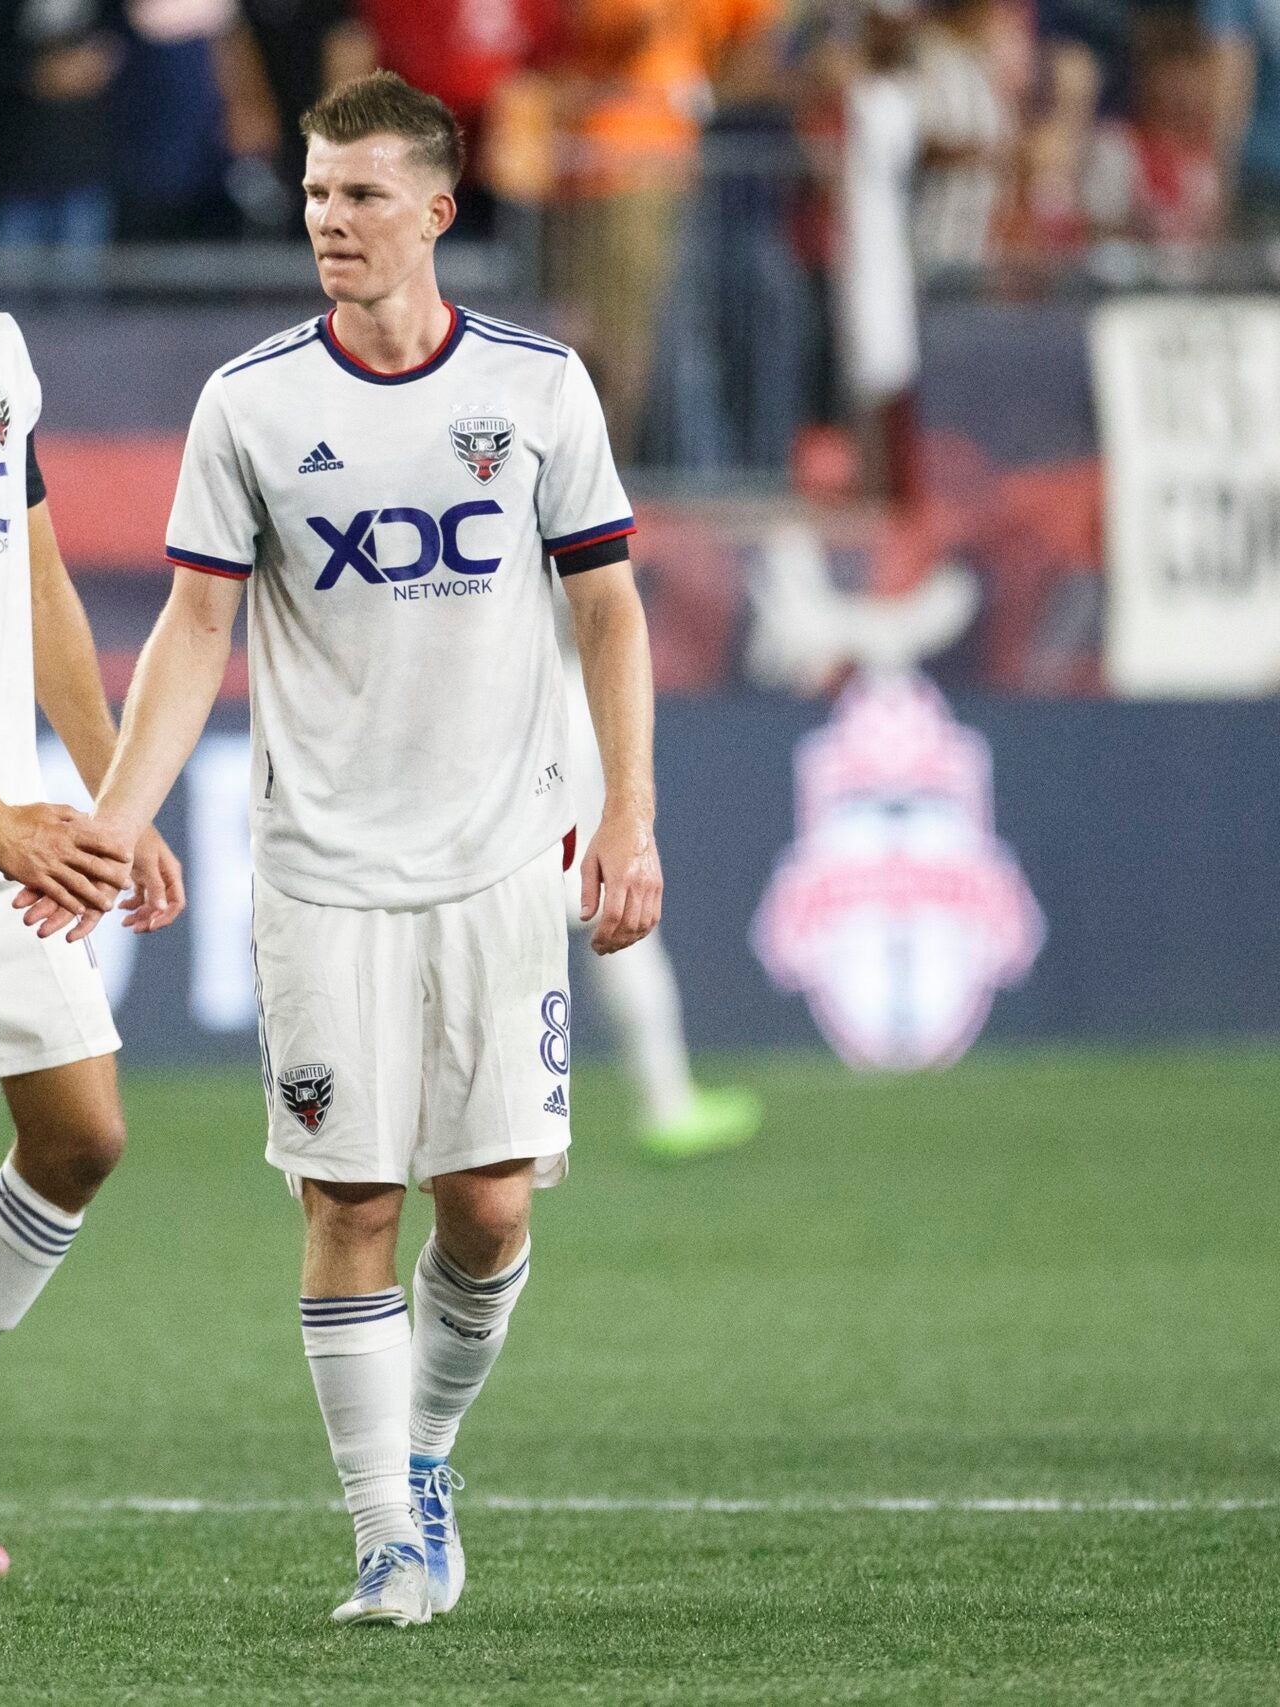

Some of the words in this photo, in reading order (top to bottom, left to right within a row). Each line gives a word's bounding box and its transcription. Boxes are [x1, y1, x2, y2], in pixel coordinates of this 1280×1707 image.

[298, 459, 345, 475] adidas
[306, 499, 504, 591] XDC
[393, 577, 494, 602] NETWORK
[540, 988, 570, 1077] 8
